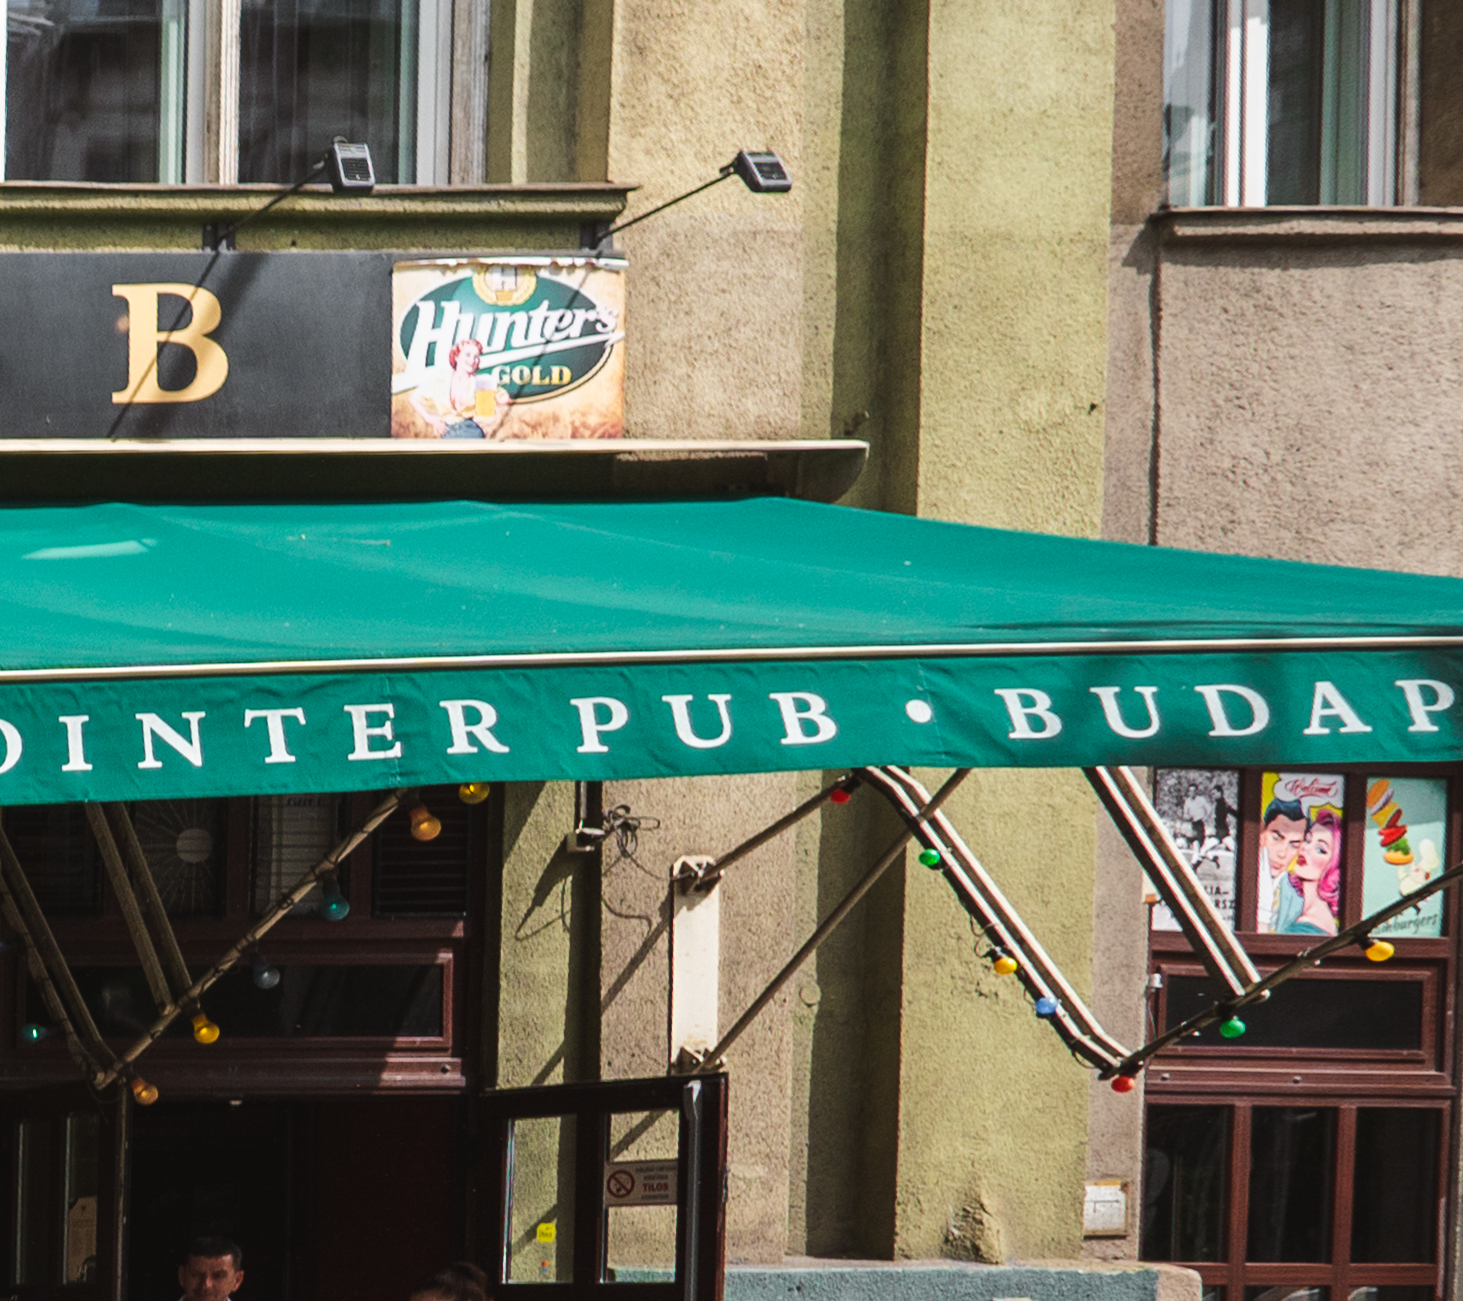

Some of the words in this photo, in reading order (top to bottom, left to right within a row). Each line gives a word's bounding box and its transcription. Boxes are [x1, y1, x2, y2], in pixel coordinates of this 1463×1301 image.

[491, 365, 572, 386] GOLD
[569, 691, 839, 753] PUB
[993, 679, 1455, 739] BUDAP
